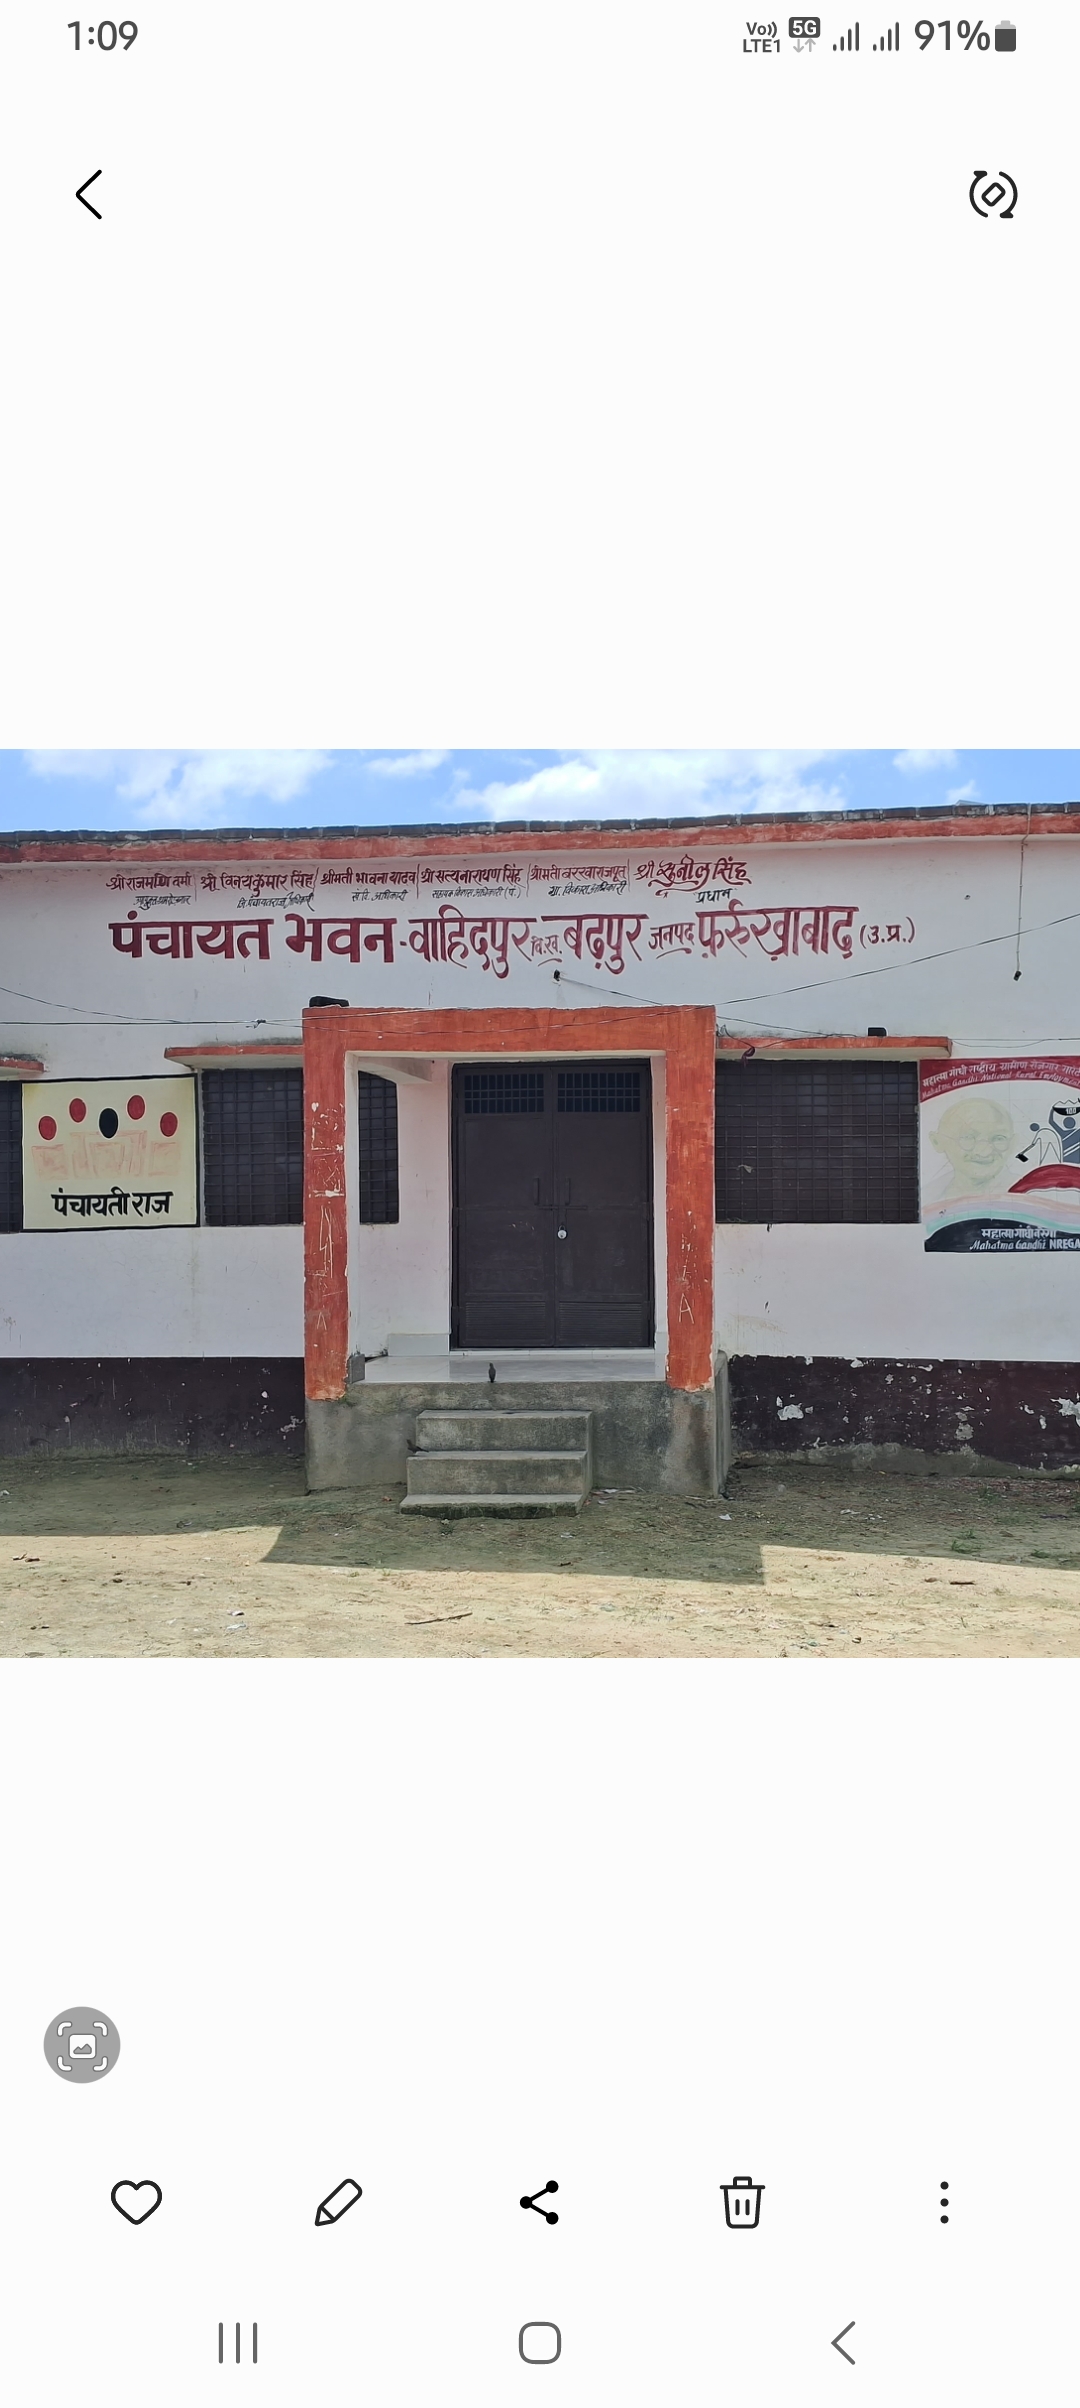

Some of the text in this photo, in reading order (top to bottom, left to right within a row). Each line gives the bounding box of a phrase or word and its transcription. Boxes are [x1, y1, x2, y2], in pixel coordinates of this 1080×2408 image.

[290, 869, 315, 890] सिंह
[320, 866, 417, 886] श्रीमती भावना यादव
[420, 867, 435, 884] श्री
[501, 863, 526, 889] सिंह
[530, 864, 561, 881] श्रीमती
[633, 853, 753, 893] श्री सुनील सिंह
[108, 910, 274, 960] पंचायत
[648, 922, 696, 951] जनपद
[922, 1071, 949, 1088] महात्मा
[51, 1186, 174, 1217] पंचायती राज
[969, 1238, 1080, 1251] Mahatma Gandhi NREGA
